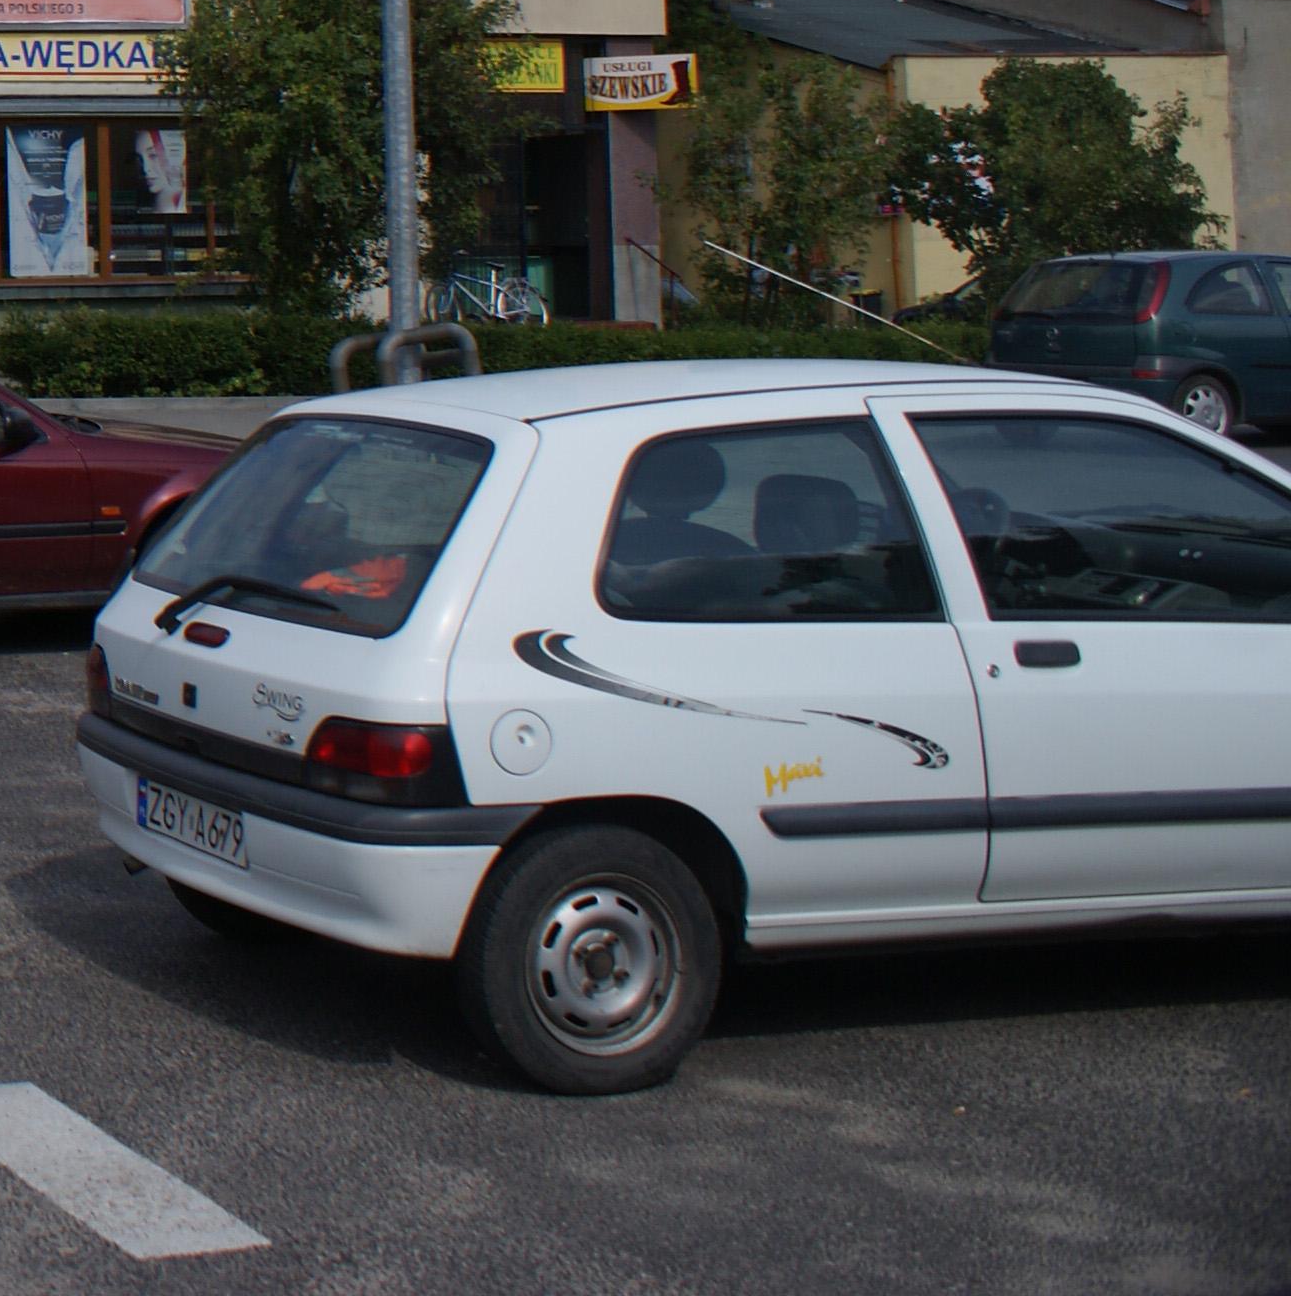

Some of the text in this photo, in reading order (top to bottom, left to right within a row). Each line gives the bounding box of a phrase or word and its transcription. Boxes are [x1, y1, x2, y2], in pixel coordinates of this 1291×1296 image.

[9, 3, 75, 15] POLSKIEGO
[77, 3, 85, 15] 3
[602, 61, 653, 73] USŁUGI
[589, 73, 668, 99] SZEWSKIE
[28, 129, 63, 140] VICHY
[252, 683, 303, 712] SWING
[149, 786, 244, 857] ZGY A679
